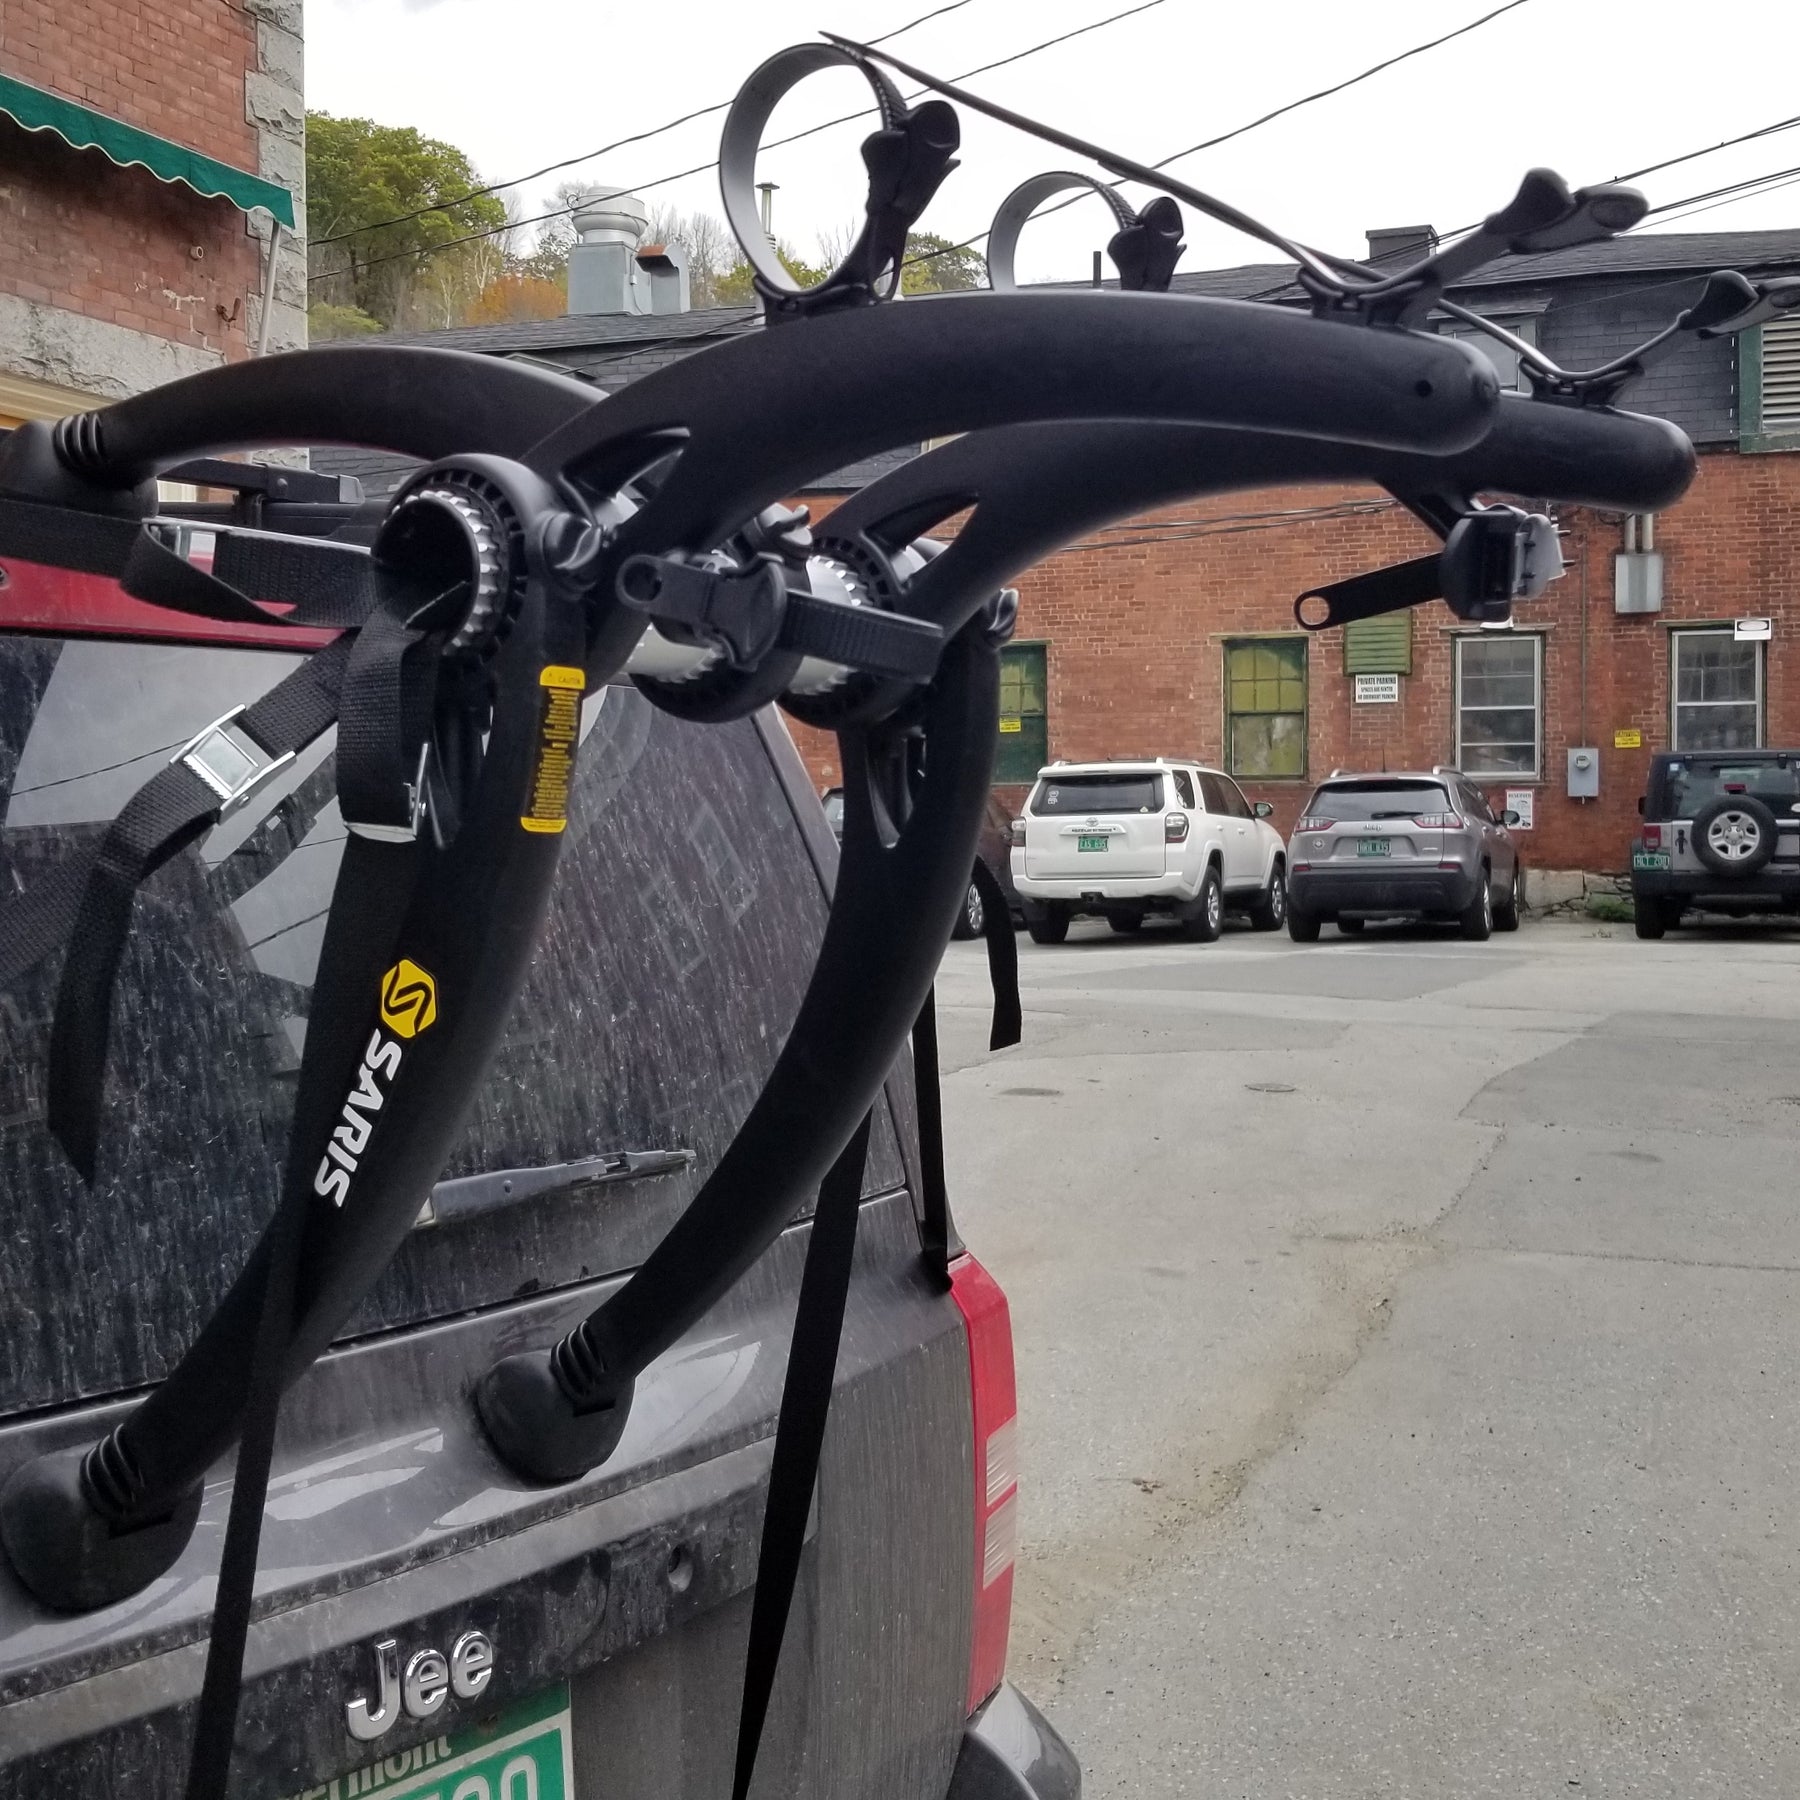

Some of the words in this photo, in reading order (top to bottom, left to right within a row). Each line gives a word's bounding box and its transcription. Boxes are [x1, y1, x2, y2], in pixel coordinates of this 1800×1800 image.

[1357, 677, 1375, 685] PRIVATE
[1376, 677, 1396, 685] PARKING
[314, 1028, 402, 1208] SARIS
[346, 1630, 493, 1740] Jee
